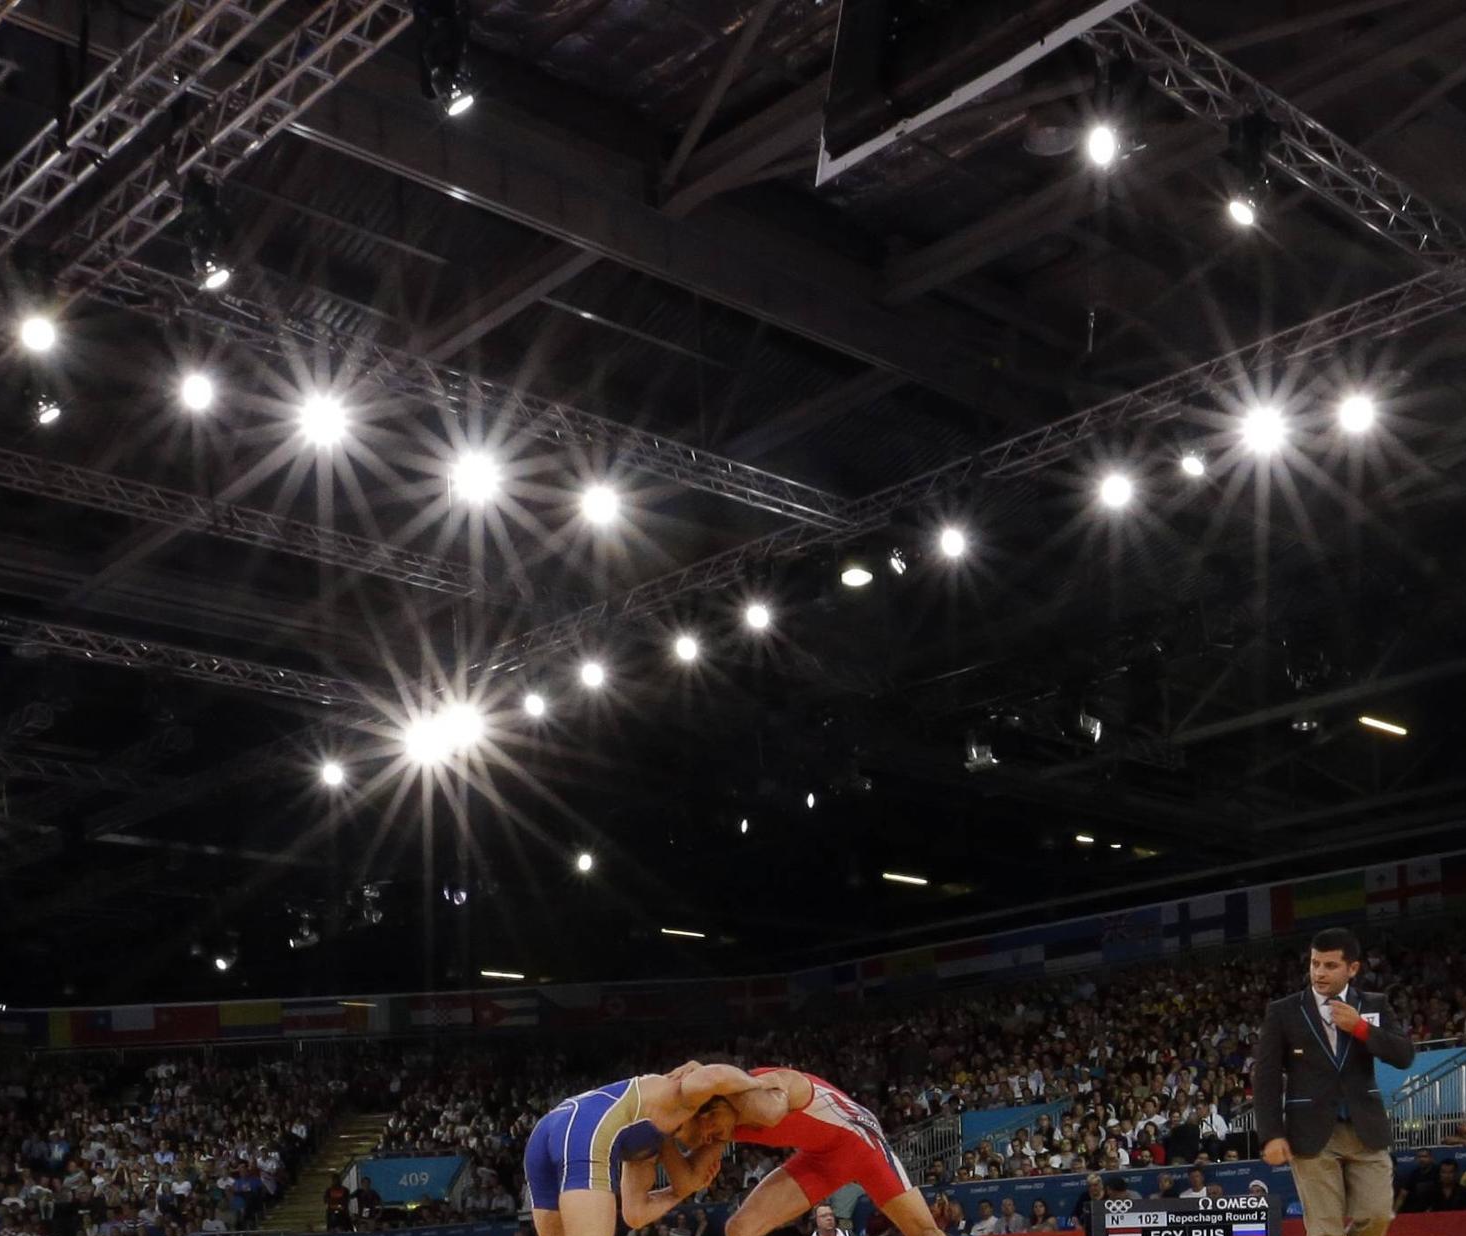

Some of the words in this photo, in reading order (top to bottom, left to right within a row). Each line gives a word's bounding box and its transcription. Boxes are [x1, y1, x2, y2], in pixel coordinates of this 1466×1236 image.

[398, 1172, 429, 1186] 409
[1217, 1197, 1269, 1209] OMEGA
[1138, 1214, 1159, 1224] 102
[1169, 1213, 1222, 1224] Repechage
[1226, 1212, 1258, 1221] Round
[1260, 1212, 1266, 1220] 2
